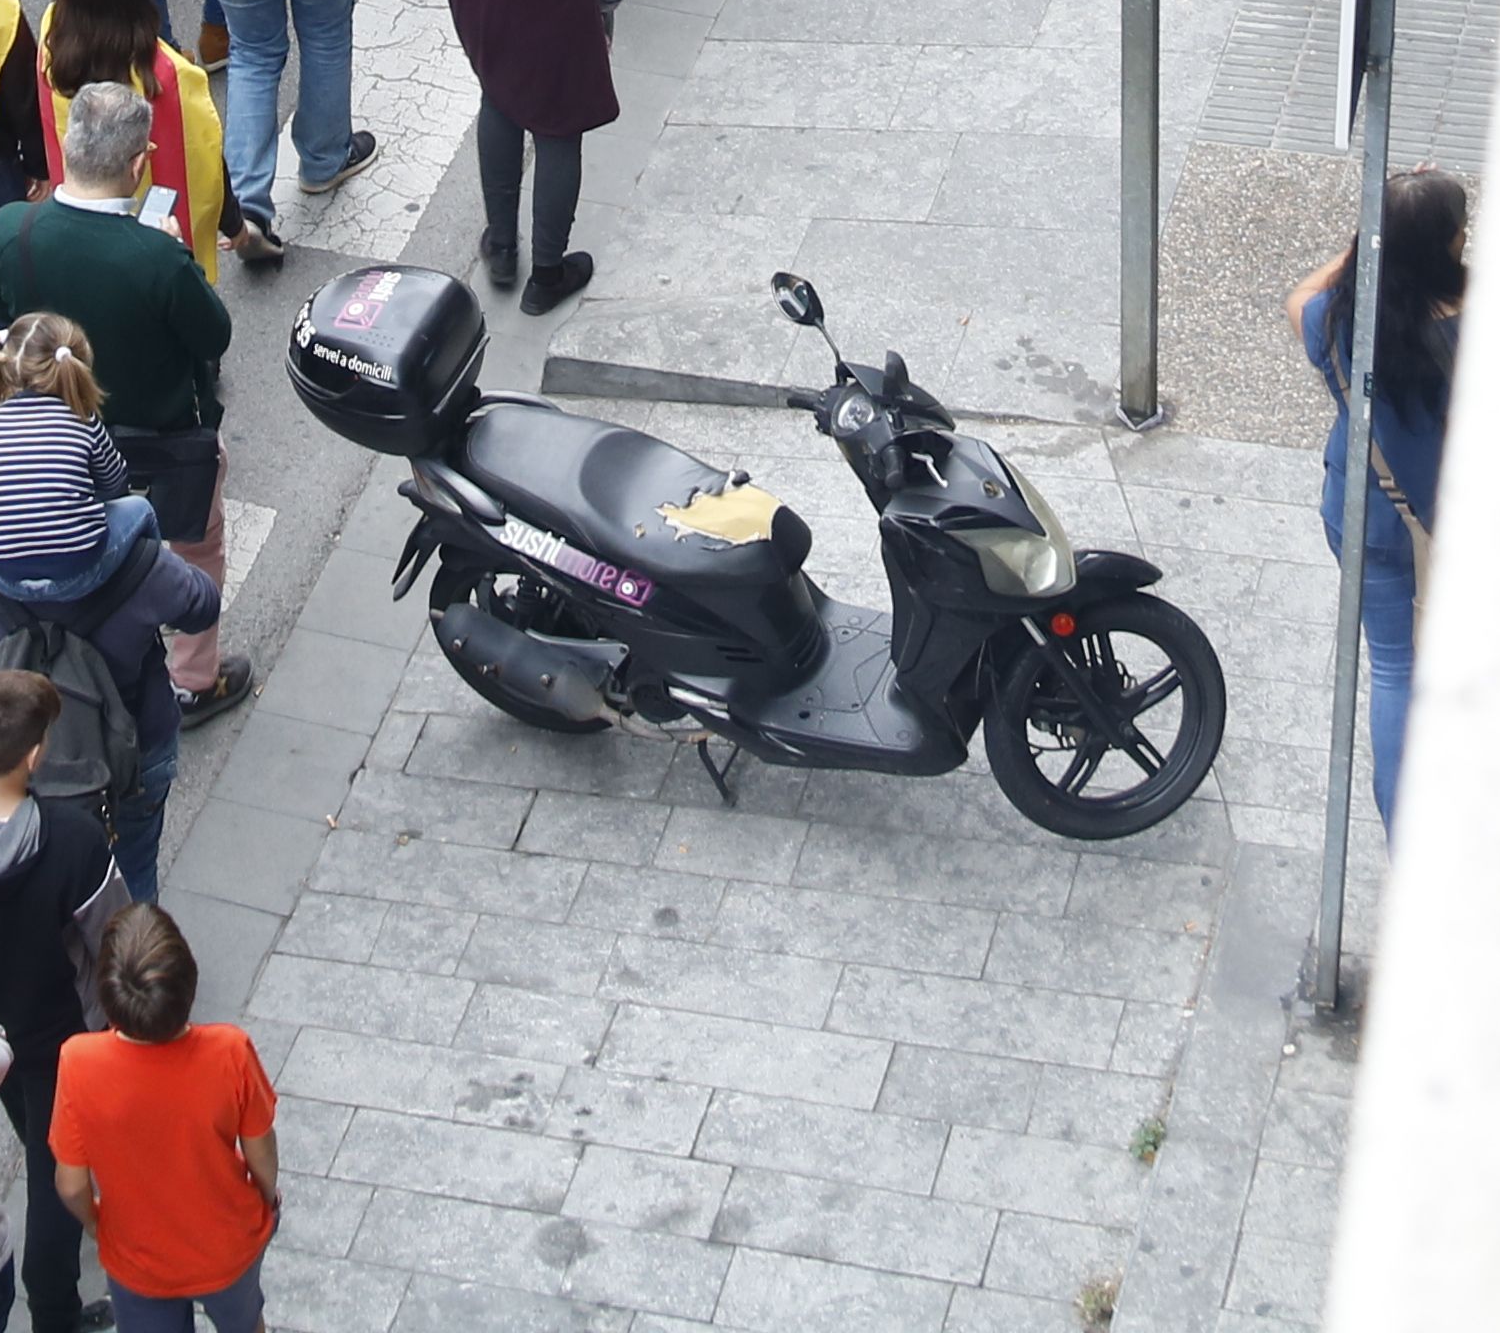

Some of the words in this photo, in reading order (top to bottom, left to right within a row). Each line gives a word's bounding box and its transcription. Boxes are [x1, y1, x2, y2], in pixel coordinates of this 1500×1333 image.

[313, 341, 342, 365] servei
[340, 356, 348, 367] a
[347, 355, 394, 382] domicili
